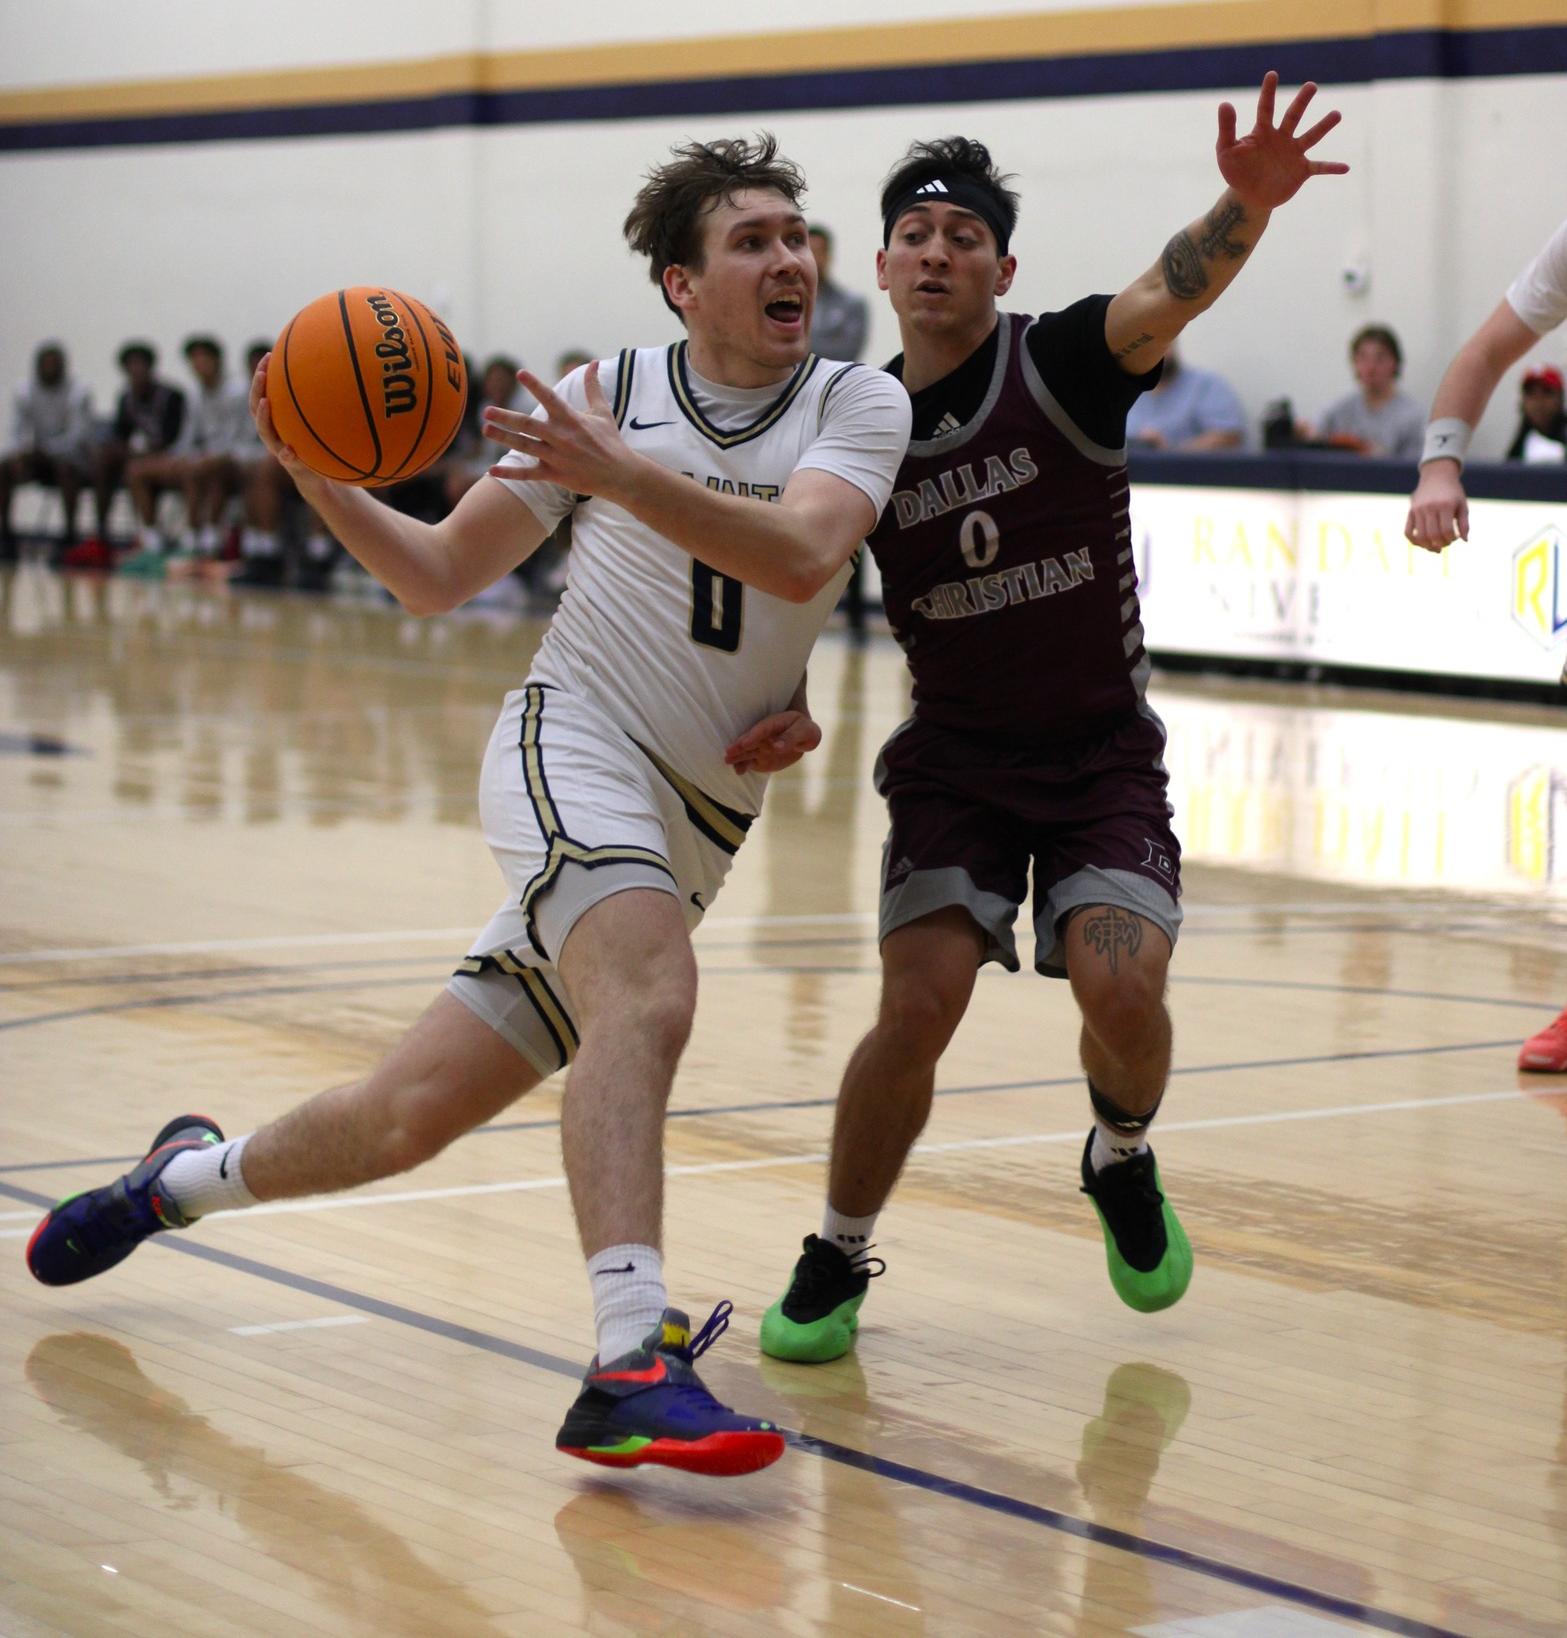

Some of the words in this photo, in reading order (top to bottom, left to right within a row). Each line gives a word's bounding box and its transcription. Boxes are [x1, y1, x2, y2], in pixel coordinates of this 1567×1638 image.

[366, 291, 418, 419] Wilson
[890, 447, 1039, 530] DALLAS
[959, 509, 1000, 569] 0
[689, 553, 746, 656] 0
[911, 547, 1096, 620] CHRISTIAN
